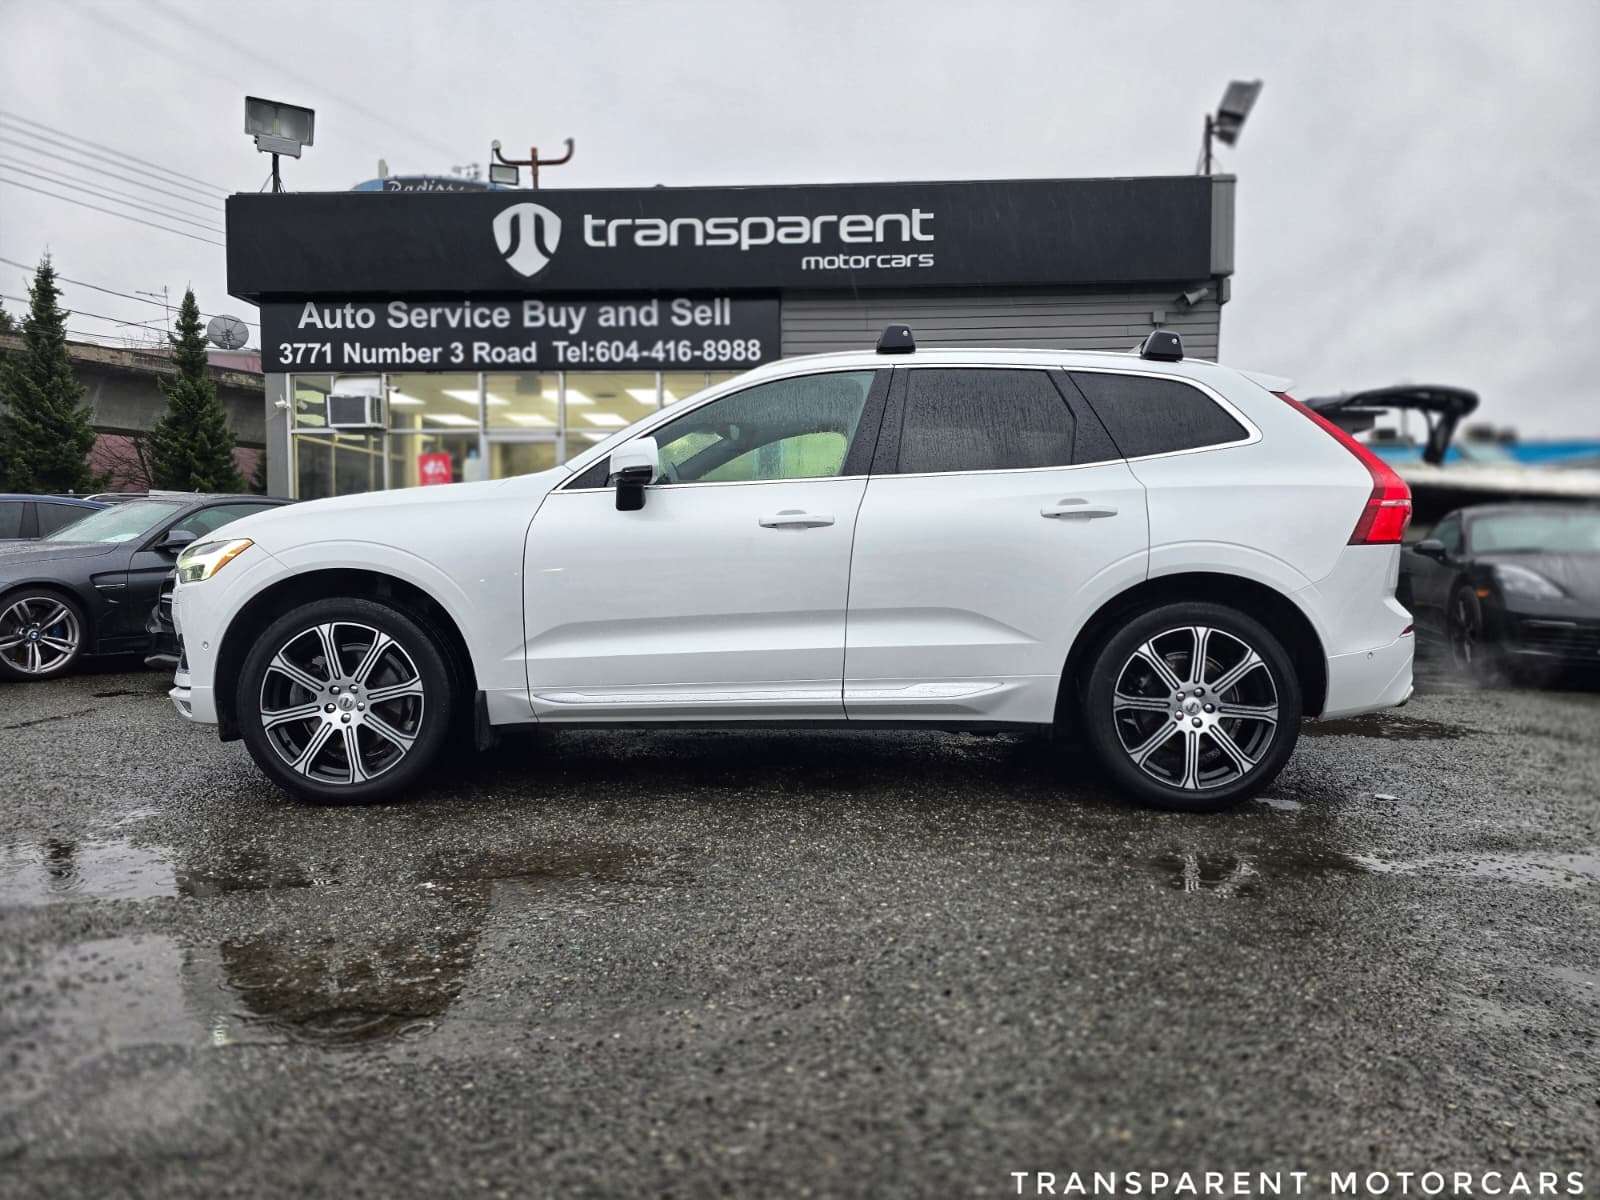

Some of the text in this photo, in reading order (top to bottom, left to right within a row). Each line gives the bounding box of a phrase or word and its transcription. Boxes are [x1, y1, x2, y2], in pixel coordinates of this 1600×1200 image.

[583, 208, 935, 251] transparent
[801, 253, 935, 270] motorcars
[297, 298, 731, 335] Auto Service Buy and Sell
[279, 338, 762, 365] 3771 Number 3 Road Tel:604-416-8988
